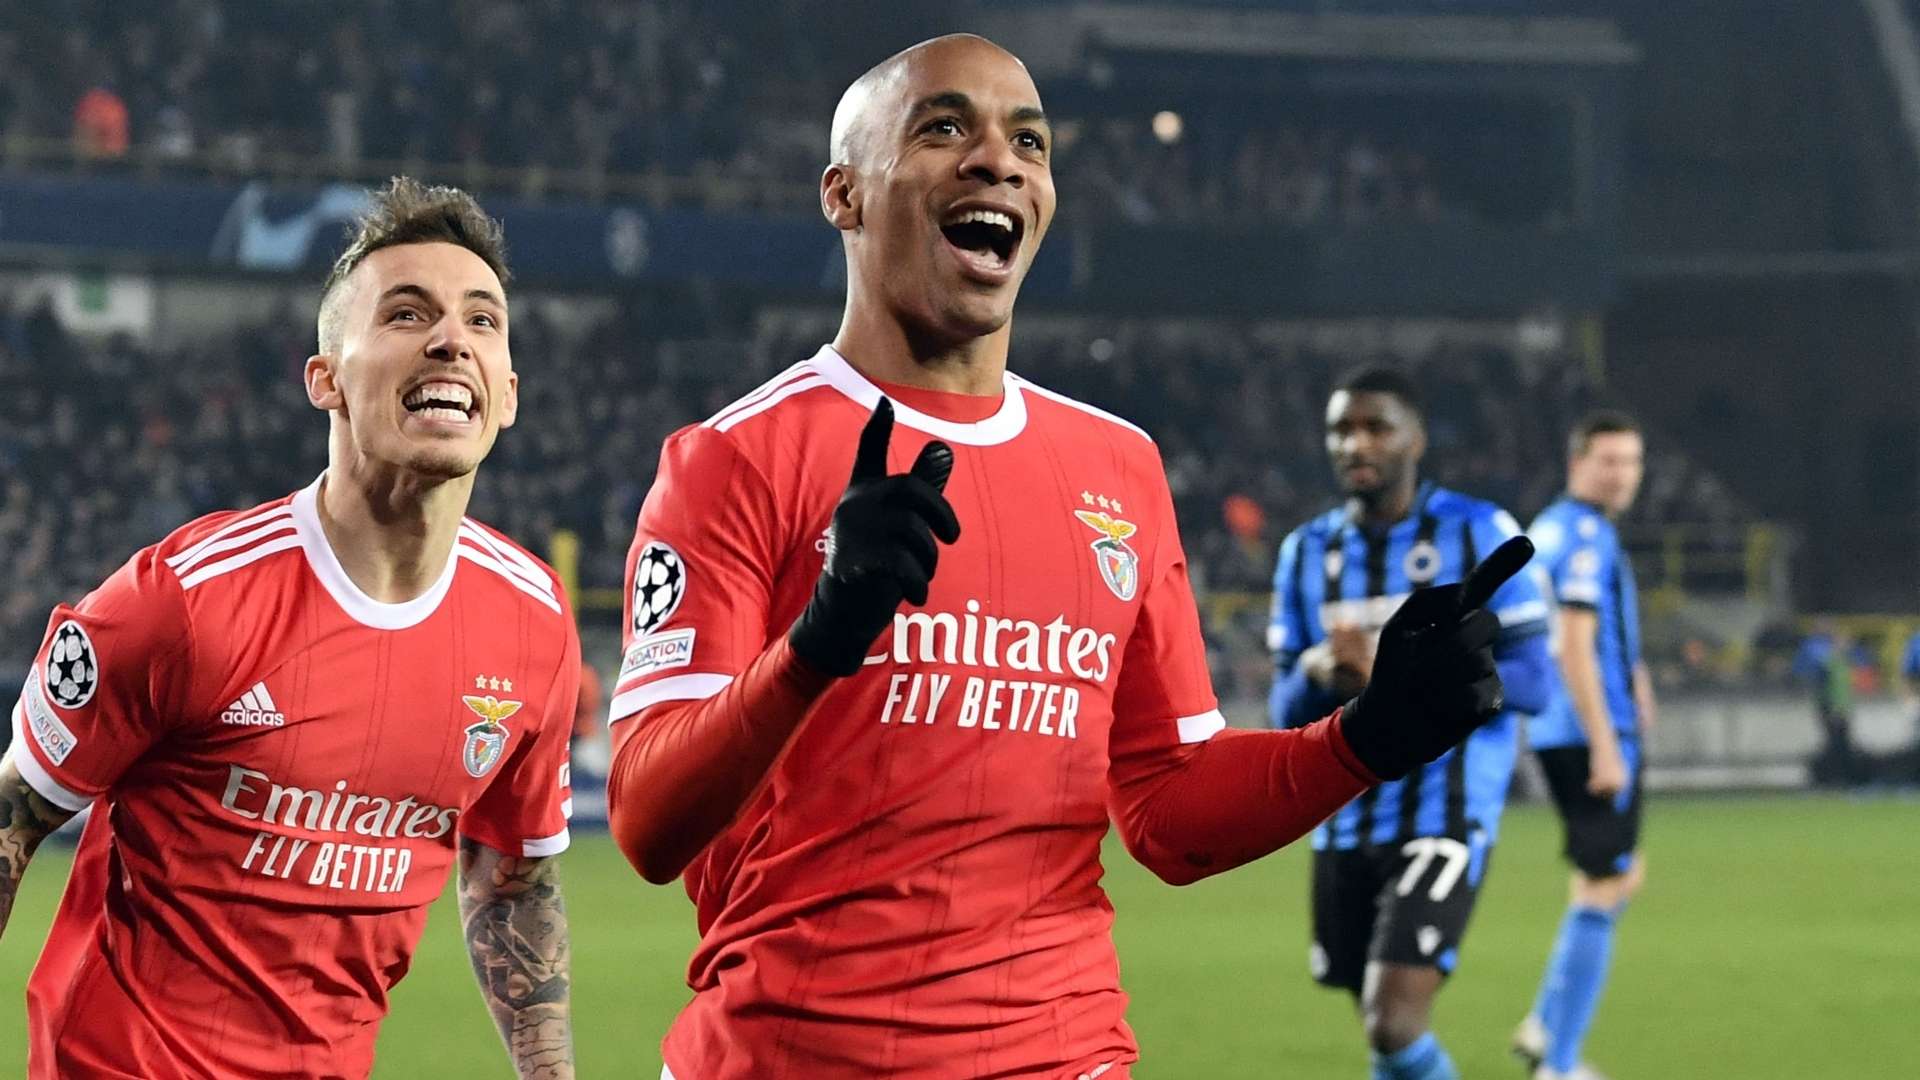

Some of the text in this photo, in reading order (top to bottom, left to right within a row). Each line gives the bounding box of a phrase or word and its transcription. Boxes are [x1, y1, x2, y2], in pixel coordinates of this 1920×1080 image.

[863, 600, 1116, 682] mirates
[220, 709, 284, 726] adidas
[880, 673, 1079, 738] FLY BETTER
[222, 764, 460, 838] Emirates
[242, 832, 411, 892] FLY BETTER
[1396, 836, 1469, 902] 77
